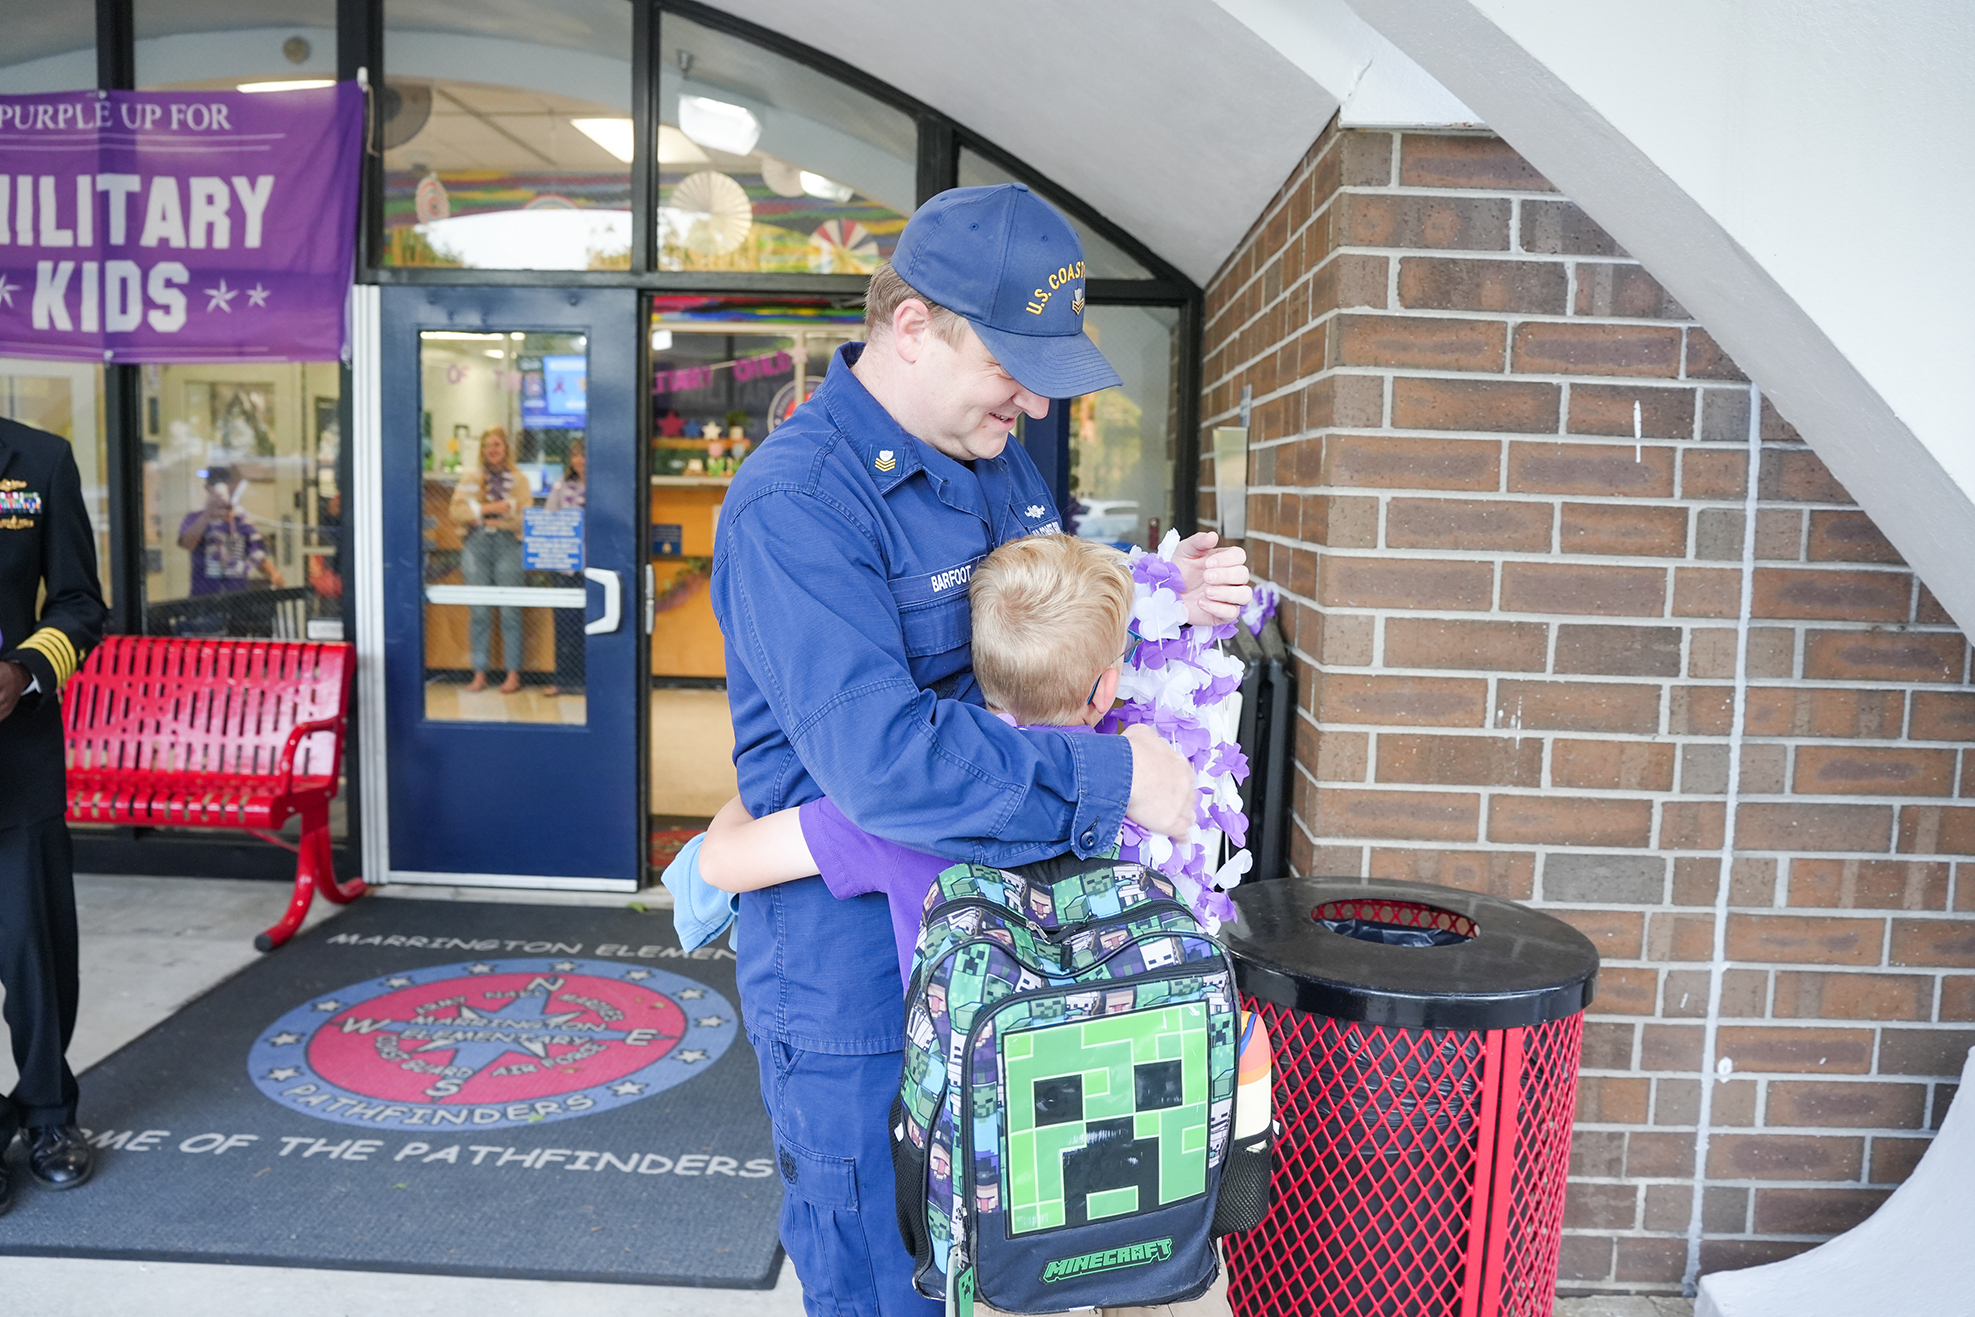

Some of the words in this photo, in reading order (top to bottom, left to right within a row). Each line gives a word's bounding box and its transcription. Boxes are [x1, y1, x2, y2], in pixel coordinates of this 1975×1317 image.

[0, 101, 113, 129] PURPLE
[120, 104, 162, 129] UP
[170, 103, 232, 130] FOR
[0, 173, 275, 249] ILITARY
[32, 260, 190, 333] KIDS
[1025, 288, 1052, 315] U.S.
[930, 565, 971, 592] BARFOOT
[326, 932, 583, 955] MARRINGTON
[527, 977, 566, 992] N
[341, 1017, 391, 1035] W
[400, 1028, 592, 1046] ELEMENTARY
[410, 1015, 607, 1033] MARRINGTON
[625, 1028, 659, 1046] E
[424, 1078, 465, 1096] S
[282, 1083, 594, 1125] PATHFINDERS
[80, 1128, 171, 1151] ME
[179, 1132, 259, 1155] OF
[278, 1136, 384, 1161] THE
[394, 1141, 774, 1178] PATHFINDERS
[1044, 1238, 1172, 1281] MINECRAFT
